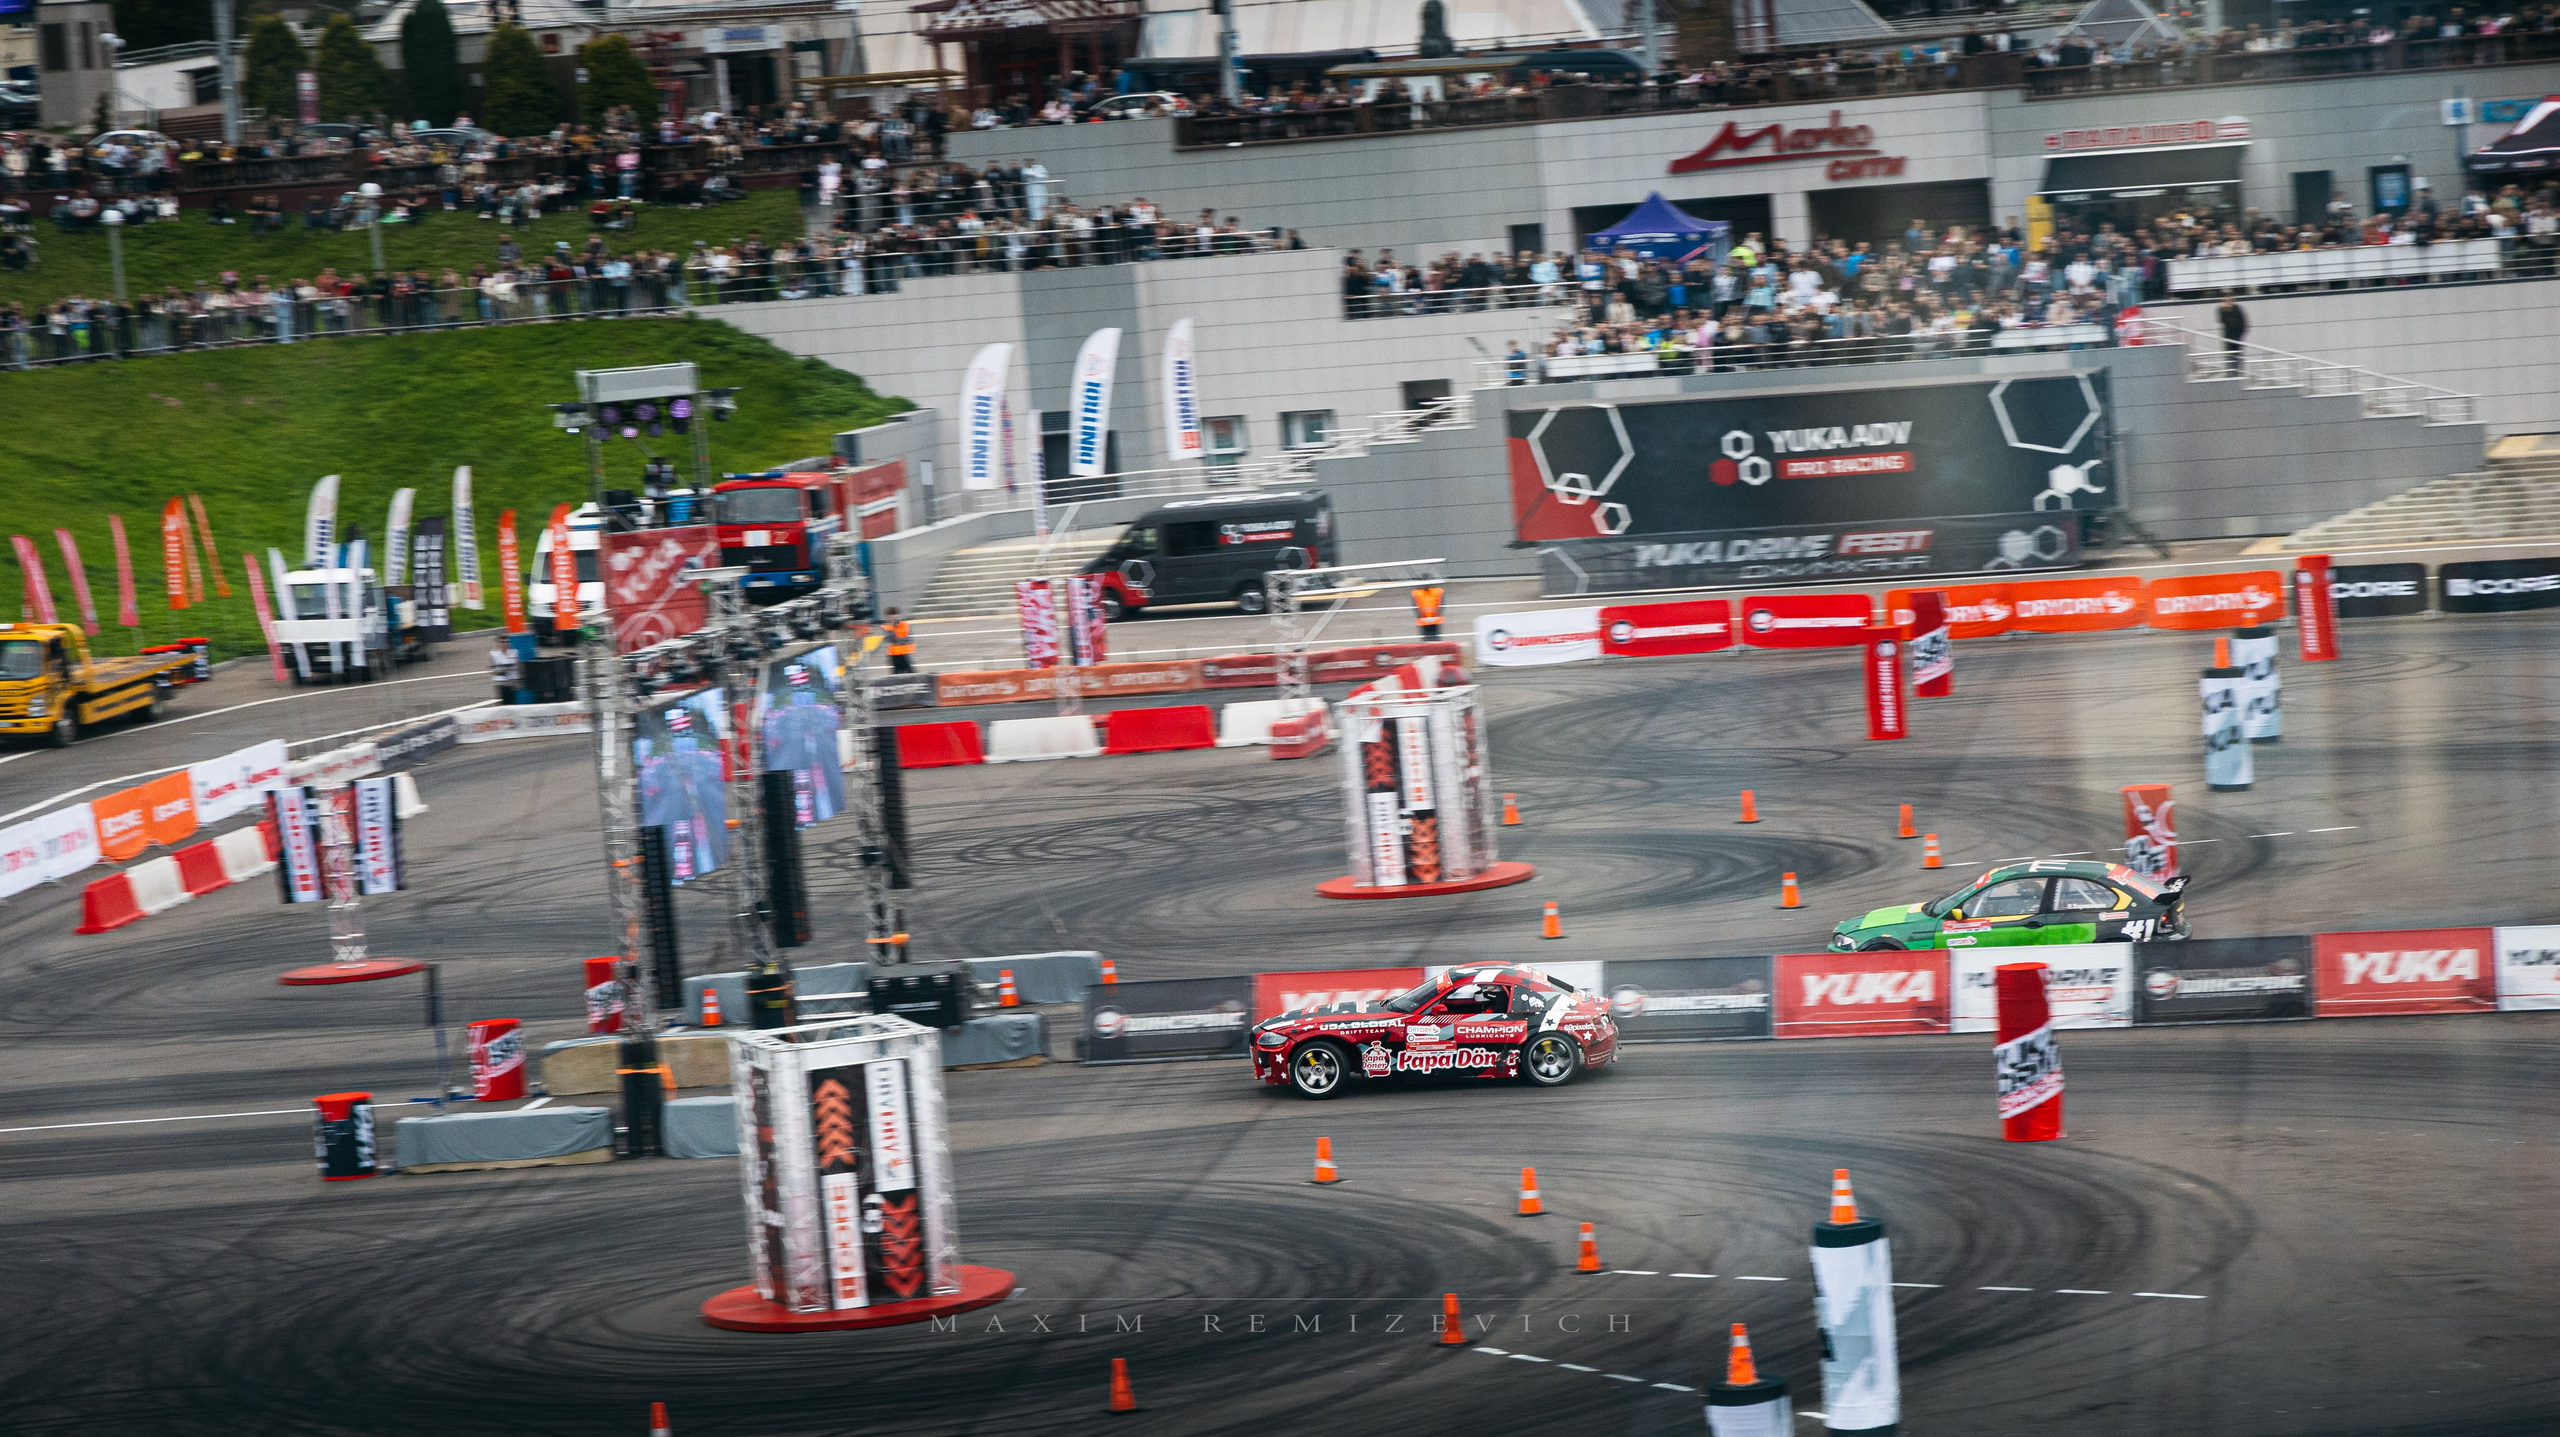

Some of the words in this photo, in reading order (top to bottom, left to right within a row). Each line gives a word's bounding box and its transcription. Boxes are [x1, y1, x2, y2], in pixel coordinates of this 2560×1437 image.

[1765, 424, 1849, 454] YUKA
[1841, 530, 1932, 554] FEST
[2340, 949, 2479, 984] YUKA
[1801, 970, 1935, 1006] YUKA
[1457, 1025, 1524, 1034] CHAMPION
[1398, 1050, 1453, 1075] Papa
[1456, 1048, 1520, 1069] Dönr
